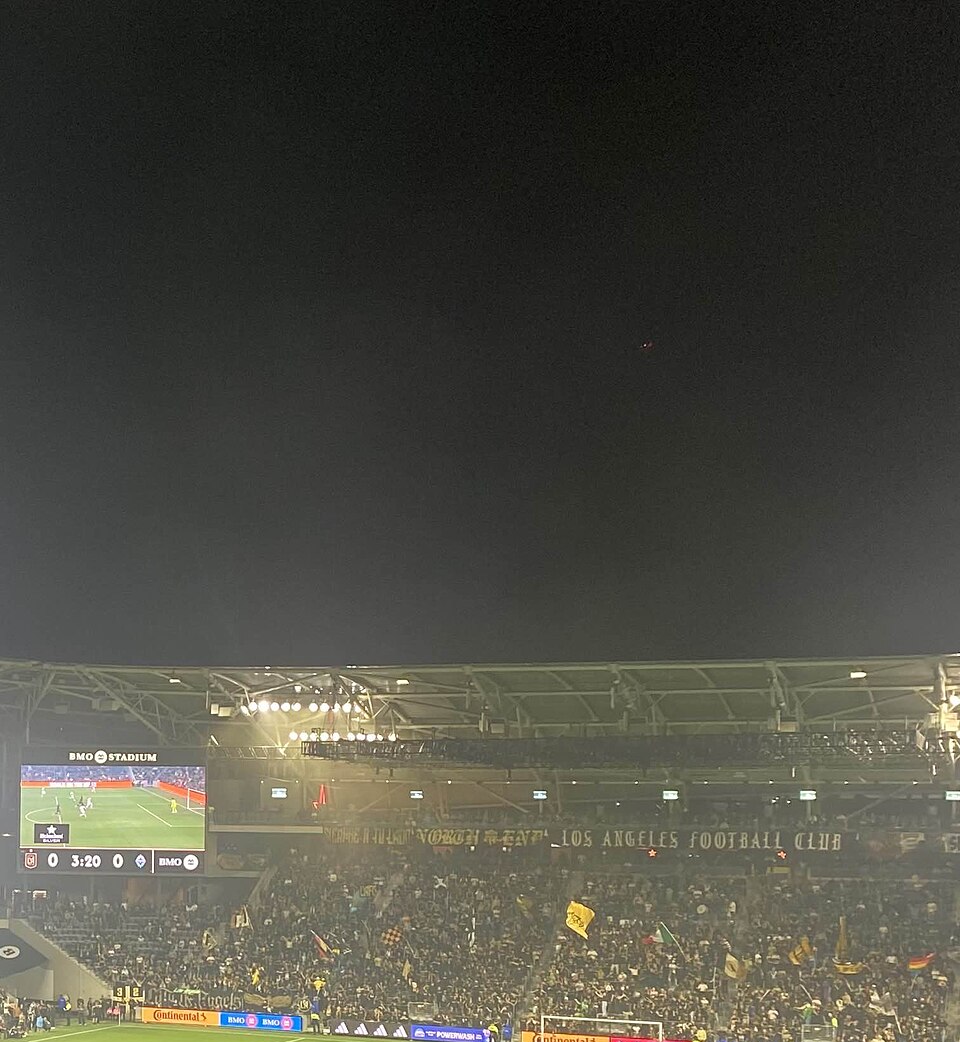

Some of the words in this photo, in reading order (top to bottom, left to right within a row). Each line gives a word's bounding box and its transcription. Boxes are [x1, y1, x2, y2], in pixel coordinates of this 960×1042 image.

[69, 752, 94, 761] BMO
[108, 752, 157, 762] STADIUM
[561, 829, 593, 848] LOS
[602, 830, 679, 849] ANGELES
[689, 831, 783, 850] FOOTBALL
[794, 832, 842, 851] CLUB
[47, 852, 59, 867] 0
[71, 854, 101, 868] 3:20
[112, 853, 124, 868] 0
[159, 857, 182, 867] BMO
[153, 1009, 200, 1021] Continental
[227, 1016, 245, 1024] BMO
[262, 1018, 280, 1027] BMO
[436, 1030, 475, 1040] POWERWASH
